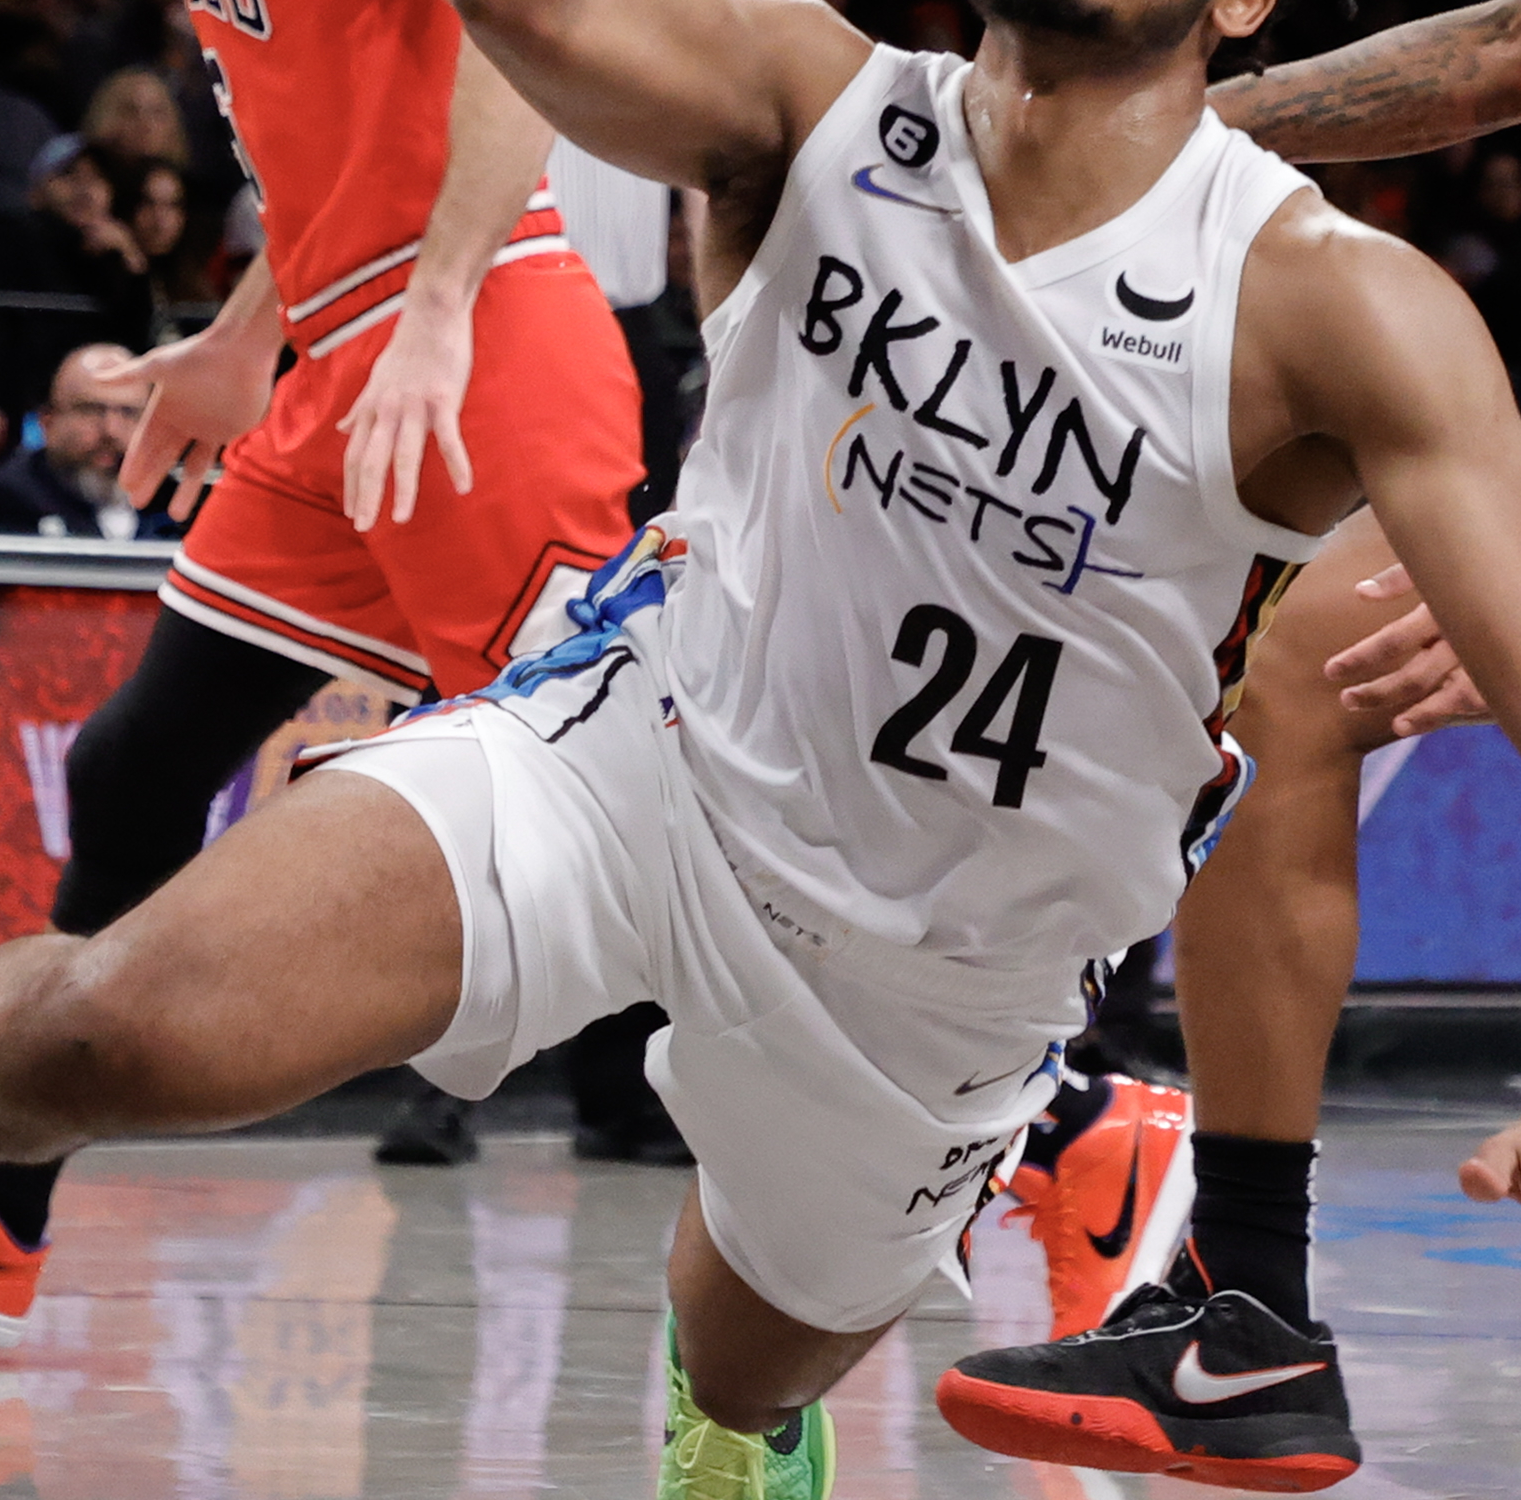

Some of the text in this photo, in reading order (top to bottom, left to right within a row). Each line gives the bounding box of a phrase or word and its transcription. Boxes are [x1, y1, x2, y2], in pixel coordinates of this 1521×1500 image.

[885, 115, 927, 161] 6
[798, 255, 1147, 525] BKLYN
[1101, 326, 1183, 364] Webull
[870, 603, 1064, 809] 24
